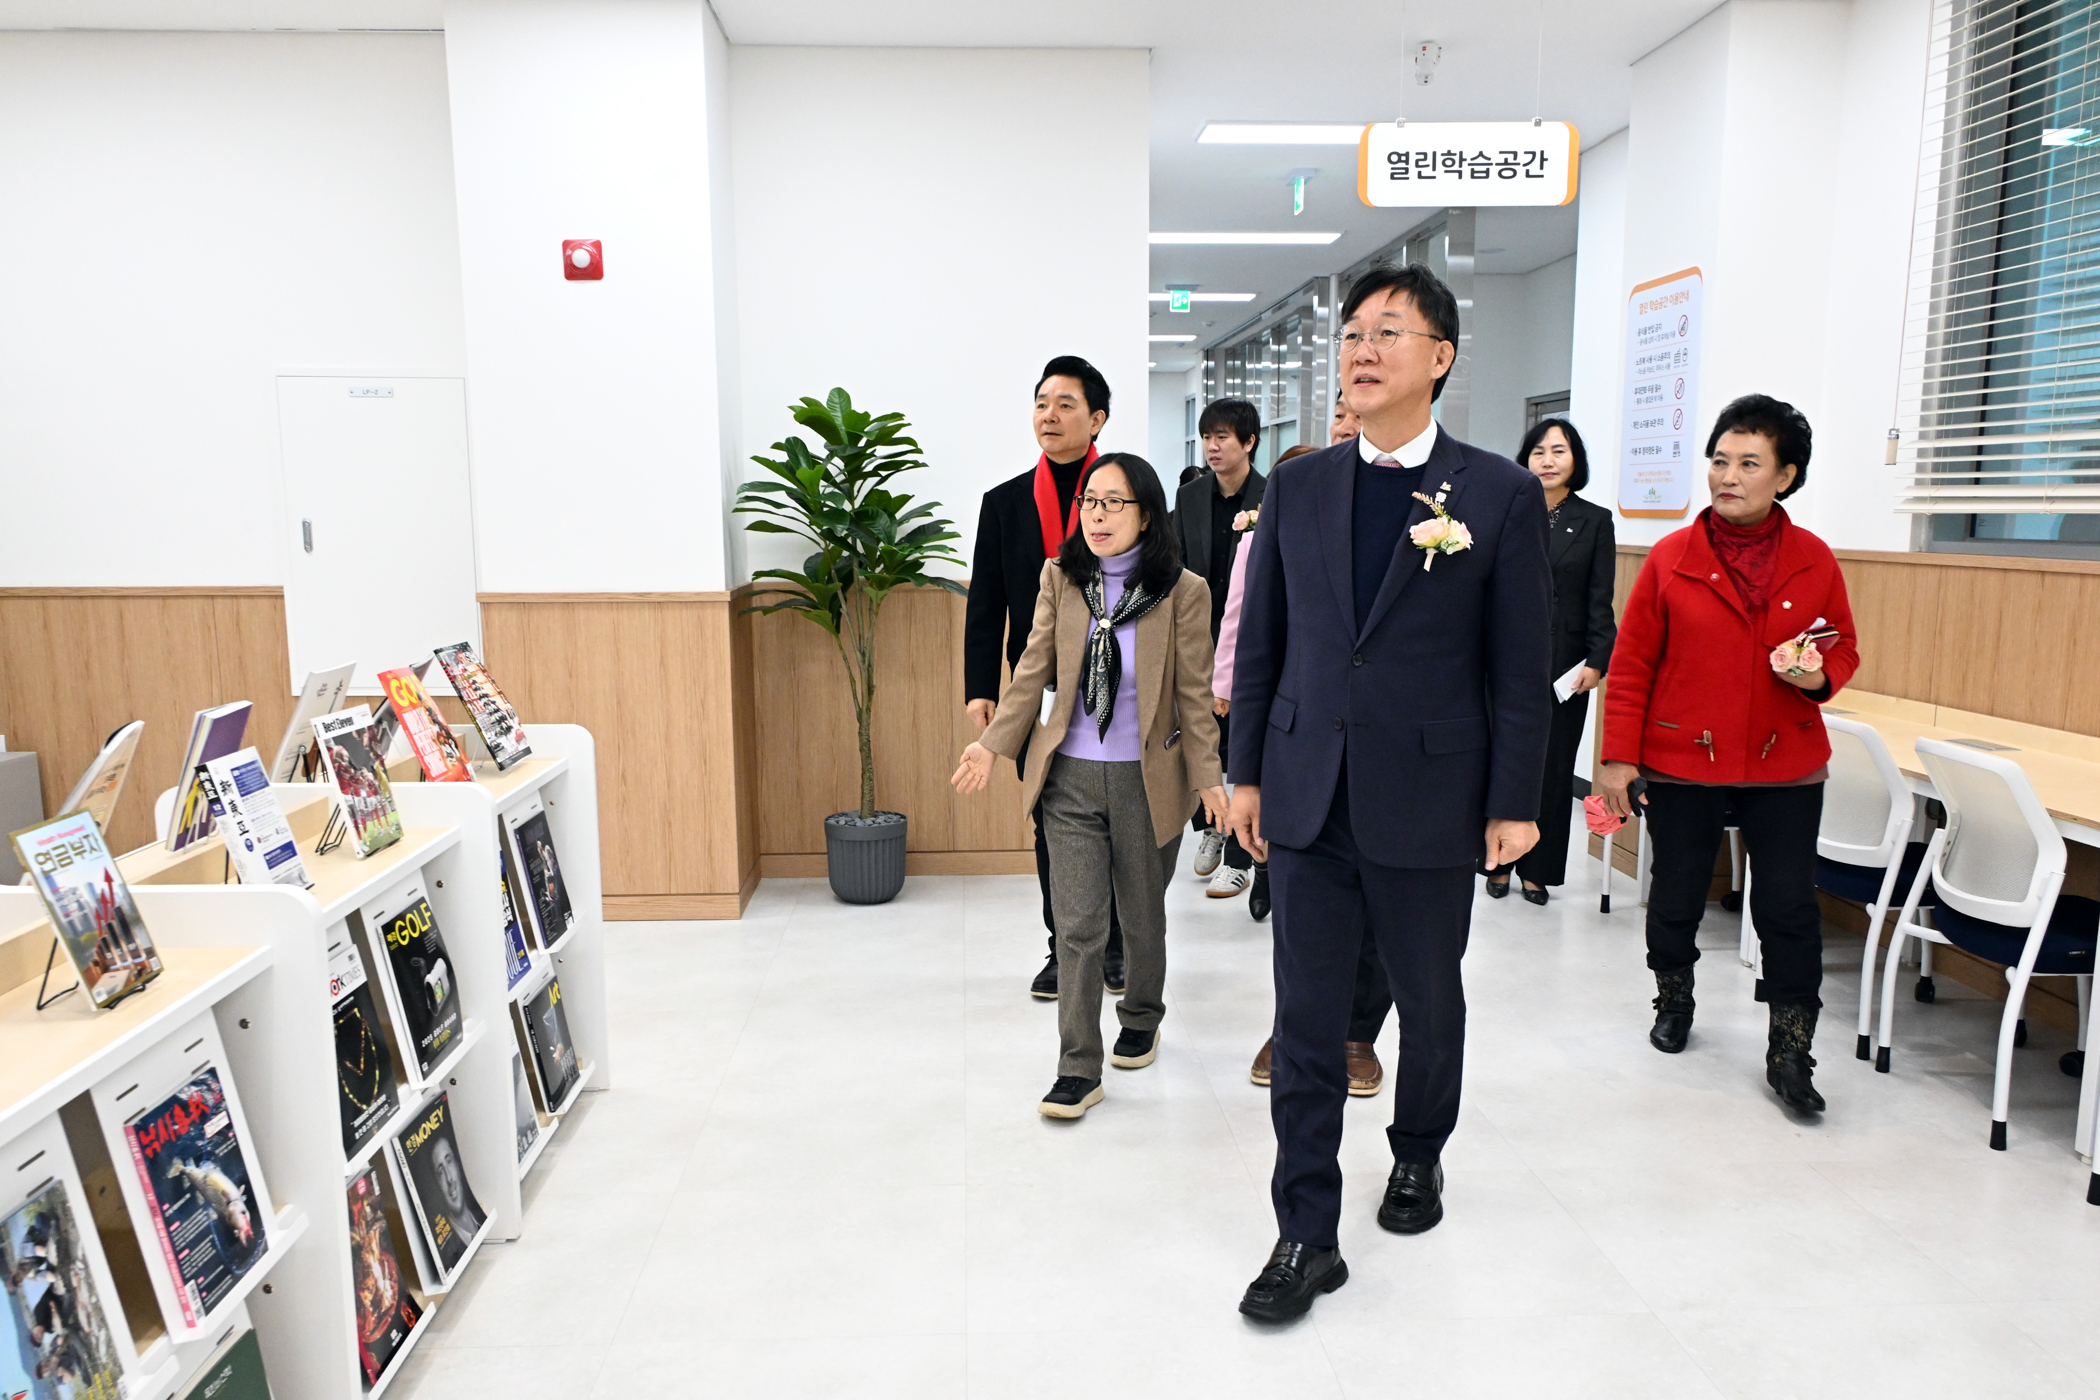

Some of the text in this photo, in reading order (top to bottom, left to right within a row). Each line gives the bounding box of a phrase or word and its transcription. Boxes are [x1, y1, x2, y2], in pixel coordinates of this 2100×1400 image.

[1387, 150, 1548, 180] 열린학습공간
[1639, 289, 1690, 315] 열린 학습공간 이용안내
[34, 832, 103, 875] 연금부자
[395, 902, 432, 946] GOLF
[548, 981, 562, 1009] Art
[433, 1023, 444, 1038] GOLF
[415, 1105, 445, 1149] MONEY
